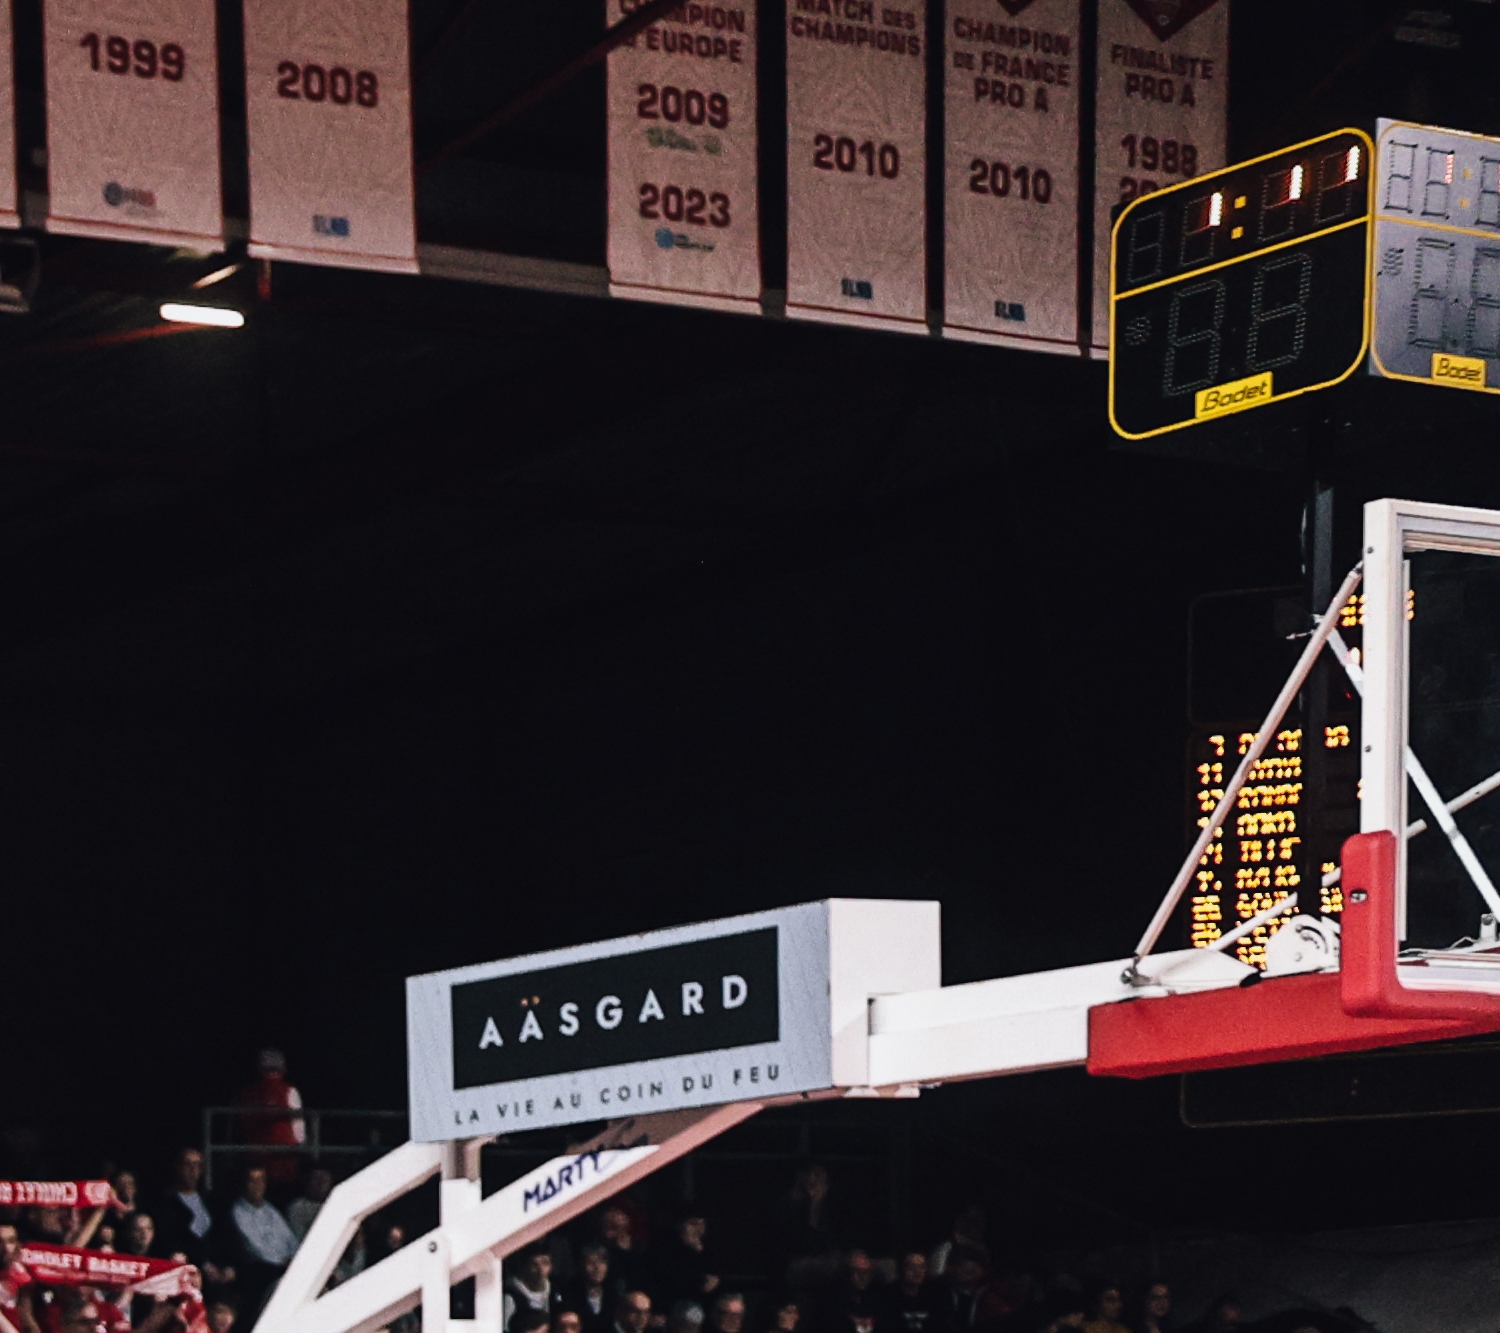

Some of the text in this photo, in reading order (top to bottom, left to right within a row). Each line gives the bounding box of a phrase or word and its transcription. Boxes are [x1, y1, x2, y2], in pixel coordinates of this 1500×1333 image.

[79, 32, 187, 83] 1999
[790, 16, 923, 57] CHAMPIONS
[952, 16, 1072, 57] CHAMPION
[276, 60, 380, 109] 2008
[980, 51, 1072, 87] FRANCE
[1124, 71, 1175, 104] PRO
[636, 83, 731, 130] 2009
[972, 76, 1050, 114] PRO A
[812, 132, 901, 180] 2010
[1120, 132, 1199, 178] 1988
[968, 157, 1053, 205] 2010
[638, 181, 732, 229] 2023
[478, 974, 749, 1051] AÄSGARD
[452, 1063, 782, 1127] LA VIE AU COIN DU FEU
